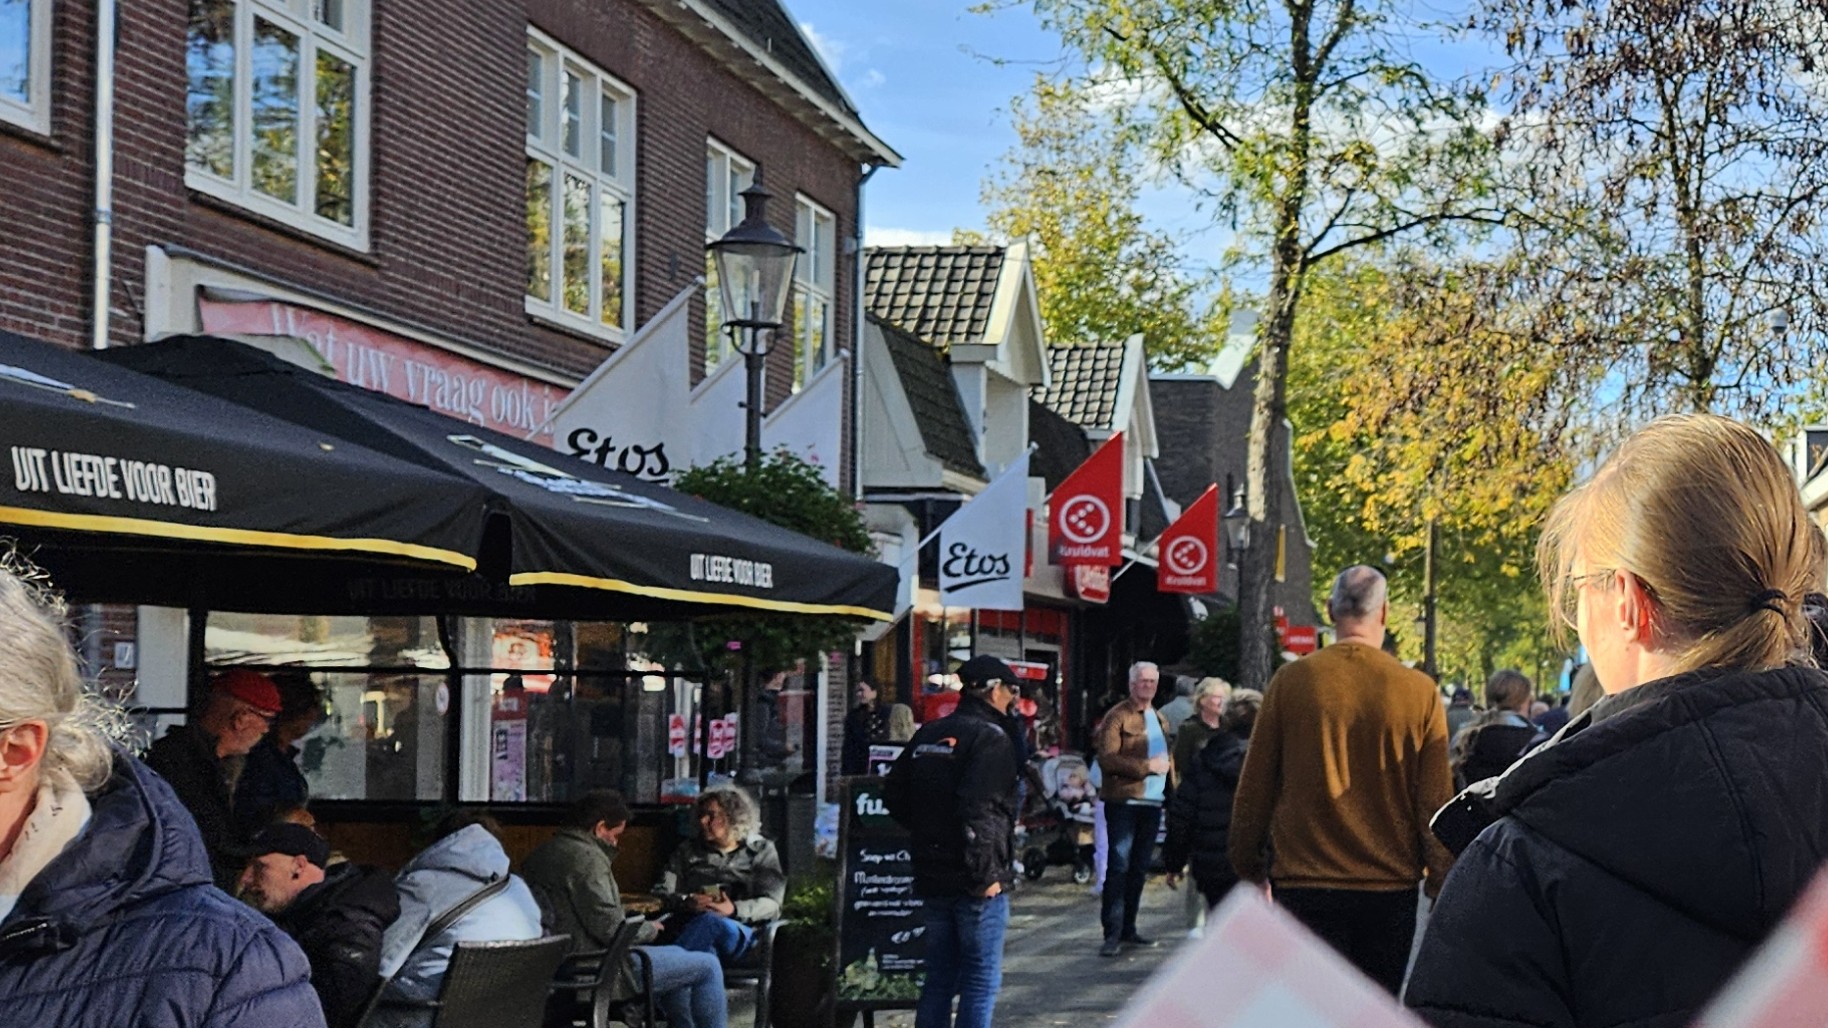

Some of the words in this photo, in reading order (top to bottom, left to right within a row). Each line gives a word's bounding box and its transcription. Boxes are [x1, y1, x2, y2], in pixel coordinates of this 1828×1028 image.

[404, 359, 486, 427] vraag
[491, 380, 536, 431] ook
[11, 446, 50, 492] UIT
[51, 450, 123, 499] LIEFDE
[120, 458, 177, 506] VOOR
[174, 467, 218, 512] BIER
[567, 427, 670, 477] Etos
[942, 542, 1011, 578] Etos
